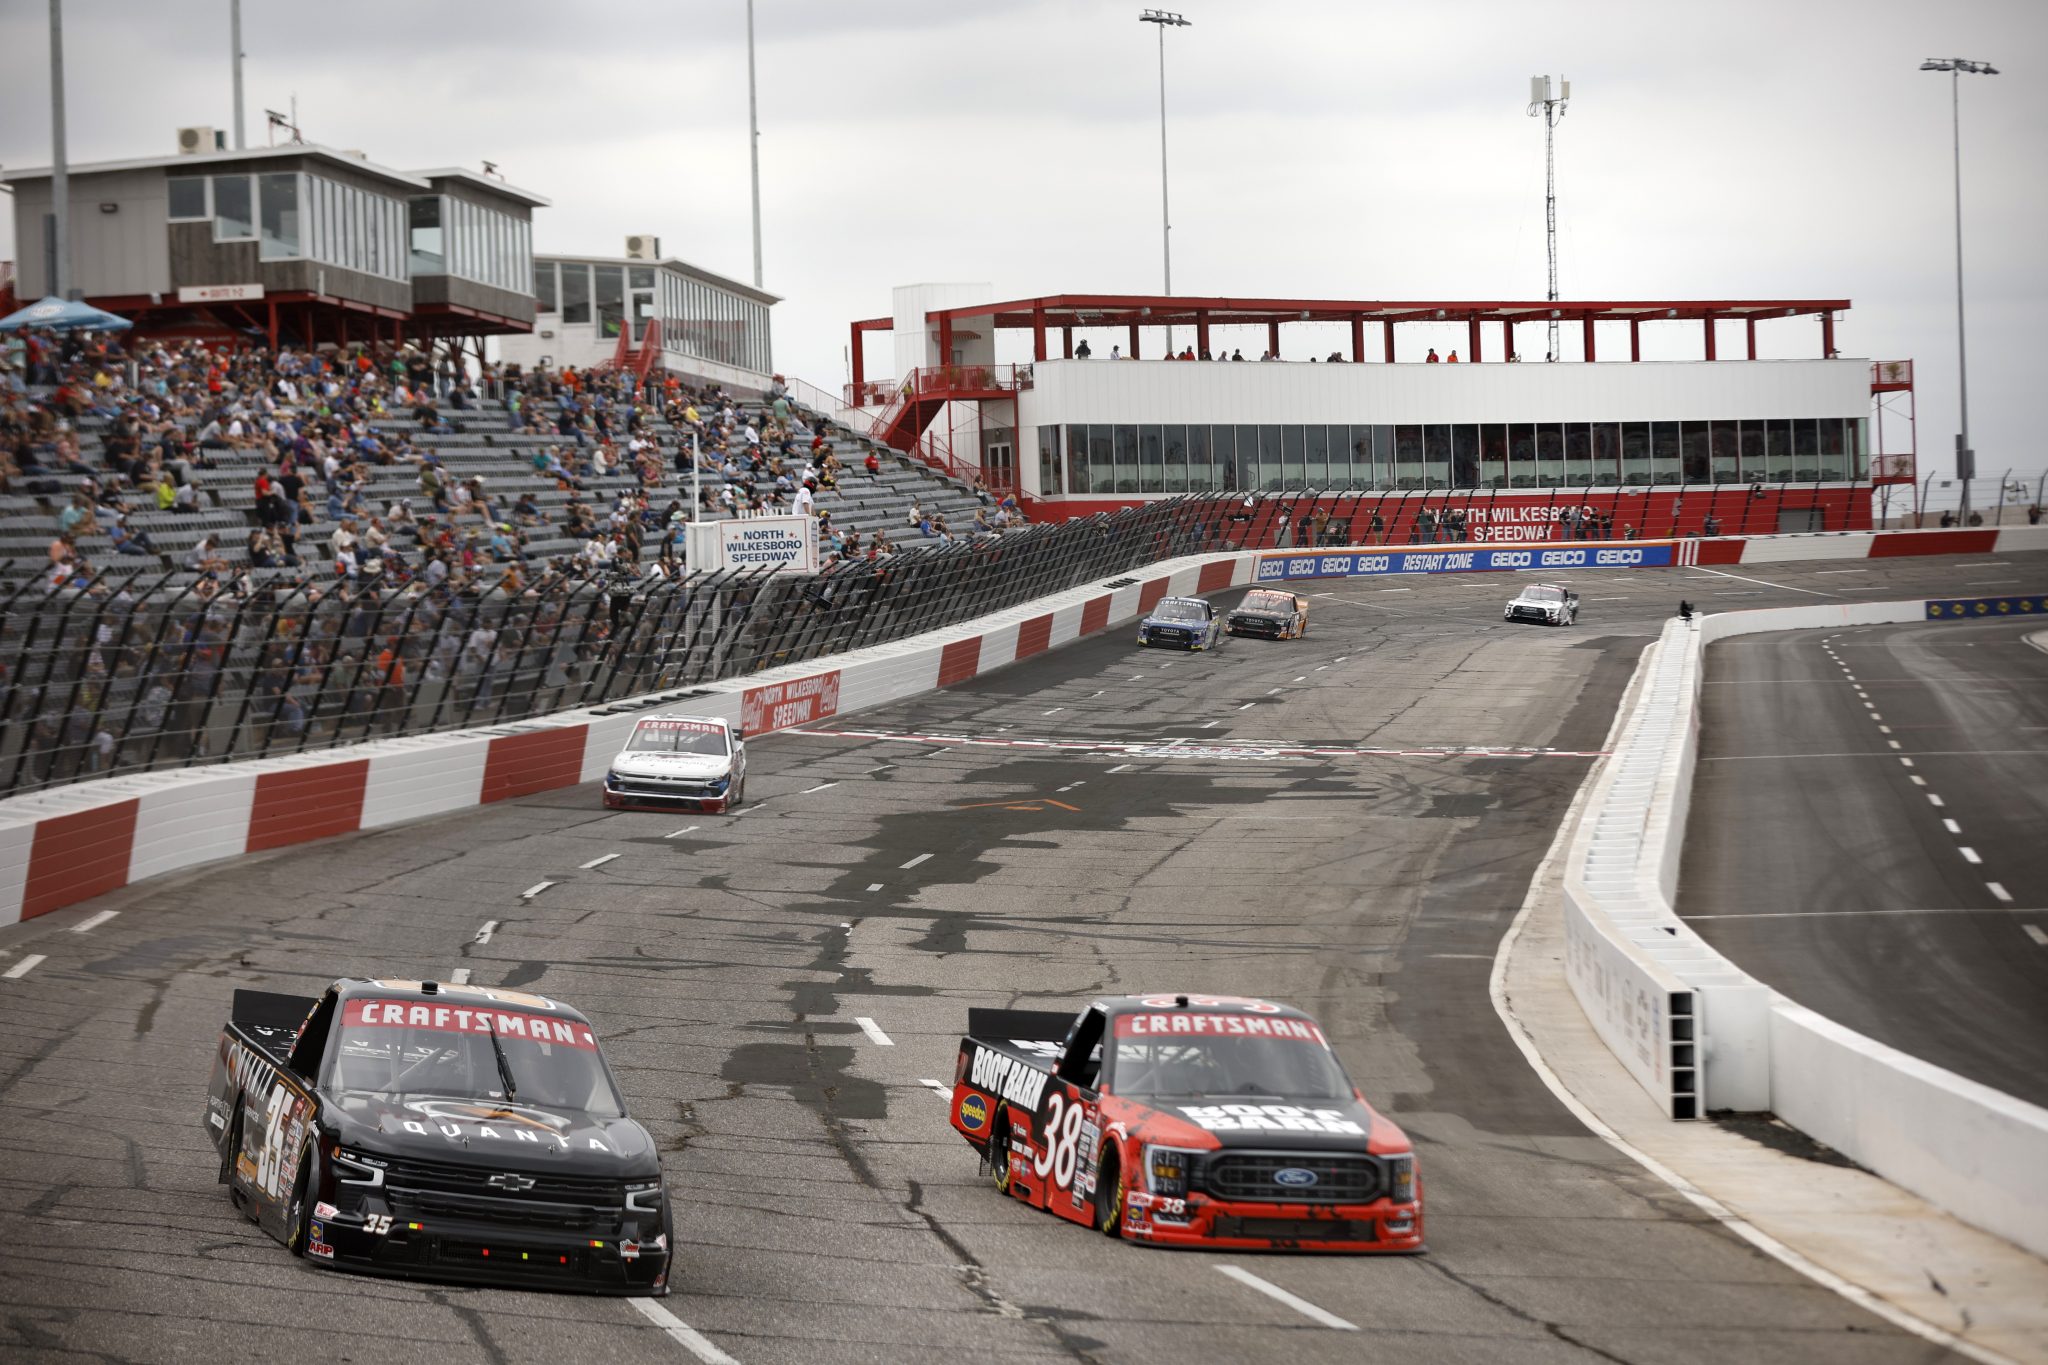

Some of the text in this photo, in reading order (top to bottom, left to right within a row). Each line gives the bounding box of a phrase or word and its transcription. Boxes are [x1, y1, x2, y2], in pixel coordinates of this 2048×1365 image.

[744, 530, 784, 540] NORTH
[1474, 525, 1553, 541] SPEEDWAY
[727, 540, 802, 552] WILKESBORO
[732, 551, 797, 562] SPEEDWAY
[1402, 553, 1474, 571] RESTART ZONE
[1490, 549, 1642, 567] GEICO GEICO GEICO
[1260, 556, 1389, 576] GEICO GEICO GEICO GEICO
[772, 698, 812, 729] SPEEDWAY
[643, 721, 719, 733] CRAFTSMAN
[361, 1004, 576, 1044] CRAFTSMAN
[1131, 1016, 1312, 1039] CRAFTSMAN
[971, 1045, 1048, 1113] BOOT BARN
[403, 1121, 609, 1151] QUANTA
[1034, 1093, 1083, 1188] 38
[1159, 1197, 1186, 1215] 38
[363, 1213, 393, 1235] 35
[309, 1242, 333, 1255] ARP
